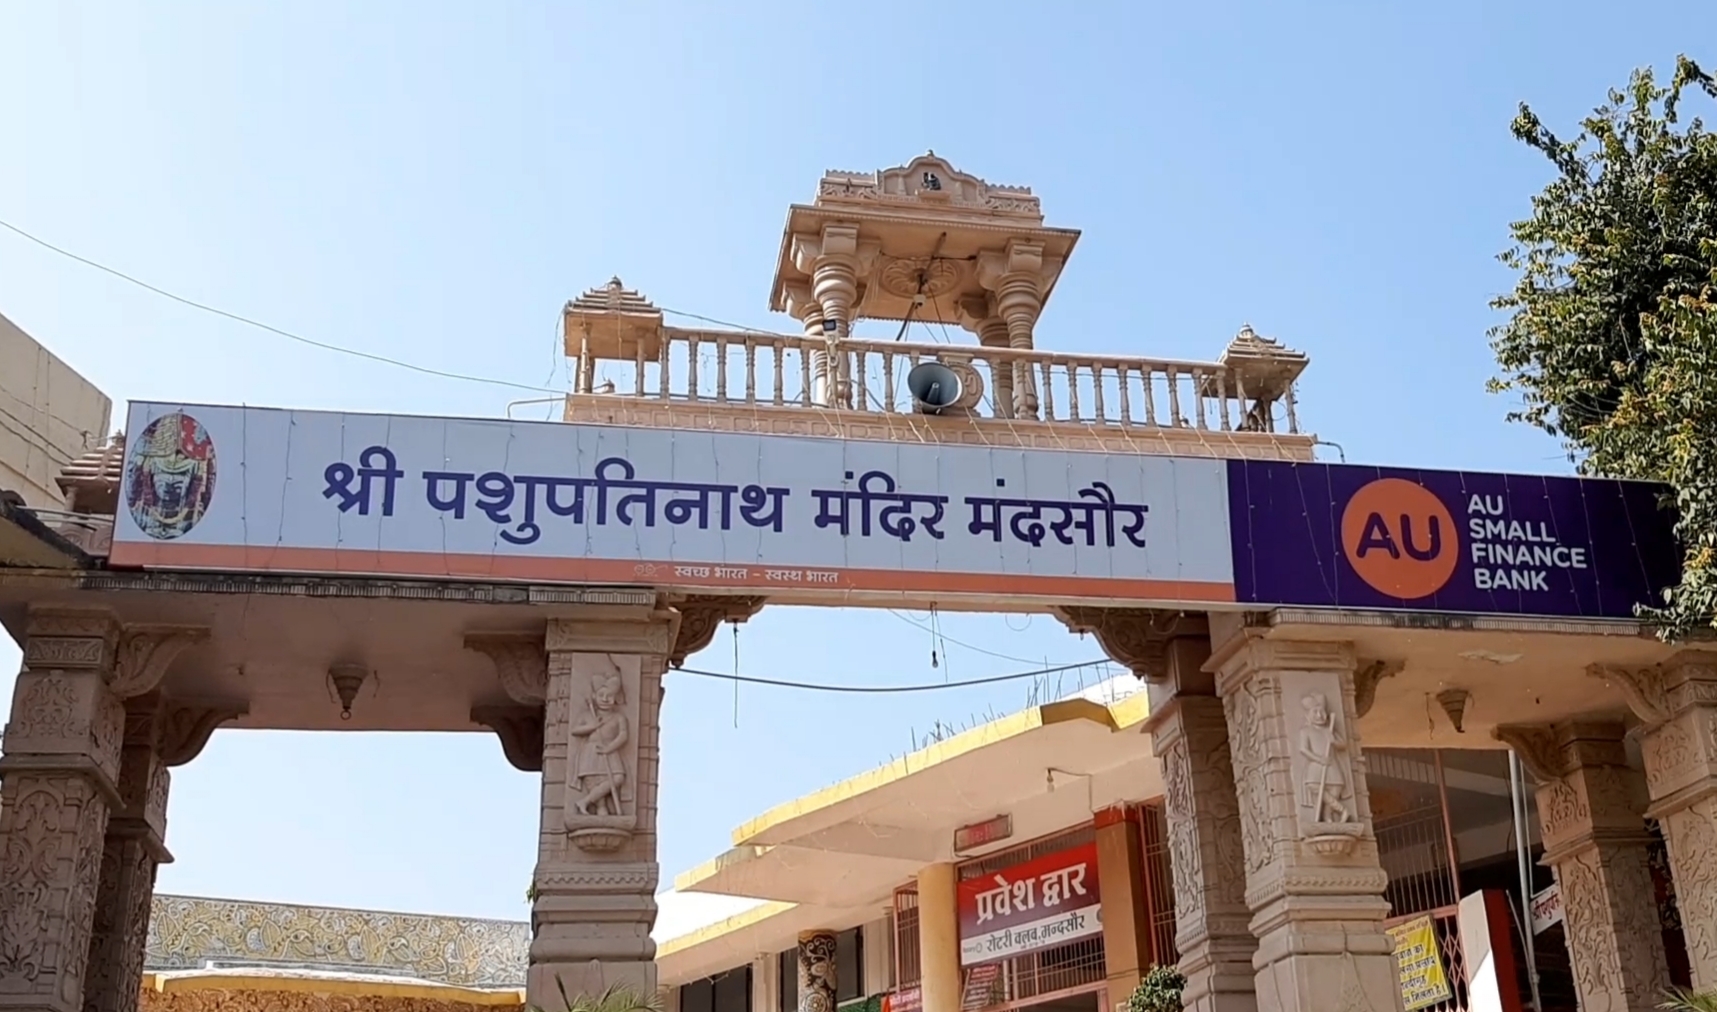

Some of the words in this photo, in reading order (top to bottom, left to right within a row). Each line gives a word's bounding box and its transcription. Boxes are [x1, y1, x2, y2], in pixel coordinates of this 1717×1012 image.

[322, 445, 404, 517] श्री
[422, 457, 790, 545] पशुपतिनाथ
[811, 471, 949, 541] मंदिर
[964, 478, 1149, 547] मंदसौर
[1467, 494, 1504, 515] AU
[1356, 512, 1441, 562] AU
[1469, 518, 1556, 542] SMALL
[1471, 543, 1588, 569] FINANCE
[674, 566, 710, 578] स्वच्छ
[714, 567, 748, 579] भारत
[765, 569, 803, 582] स्वस्थ
[806, 570, 839, 583] भारत
[1474, 568, 1549, 591] BANK
[975, 873, 1036, 925] प्रवेश
[1040, 862, 1087, 907] द्वार
[986, 929, 1012, 952] रोटरी
